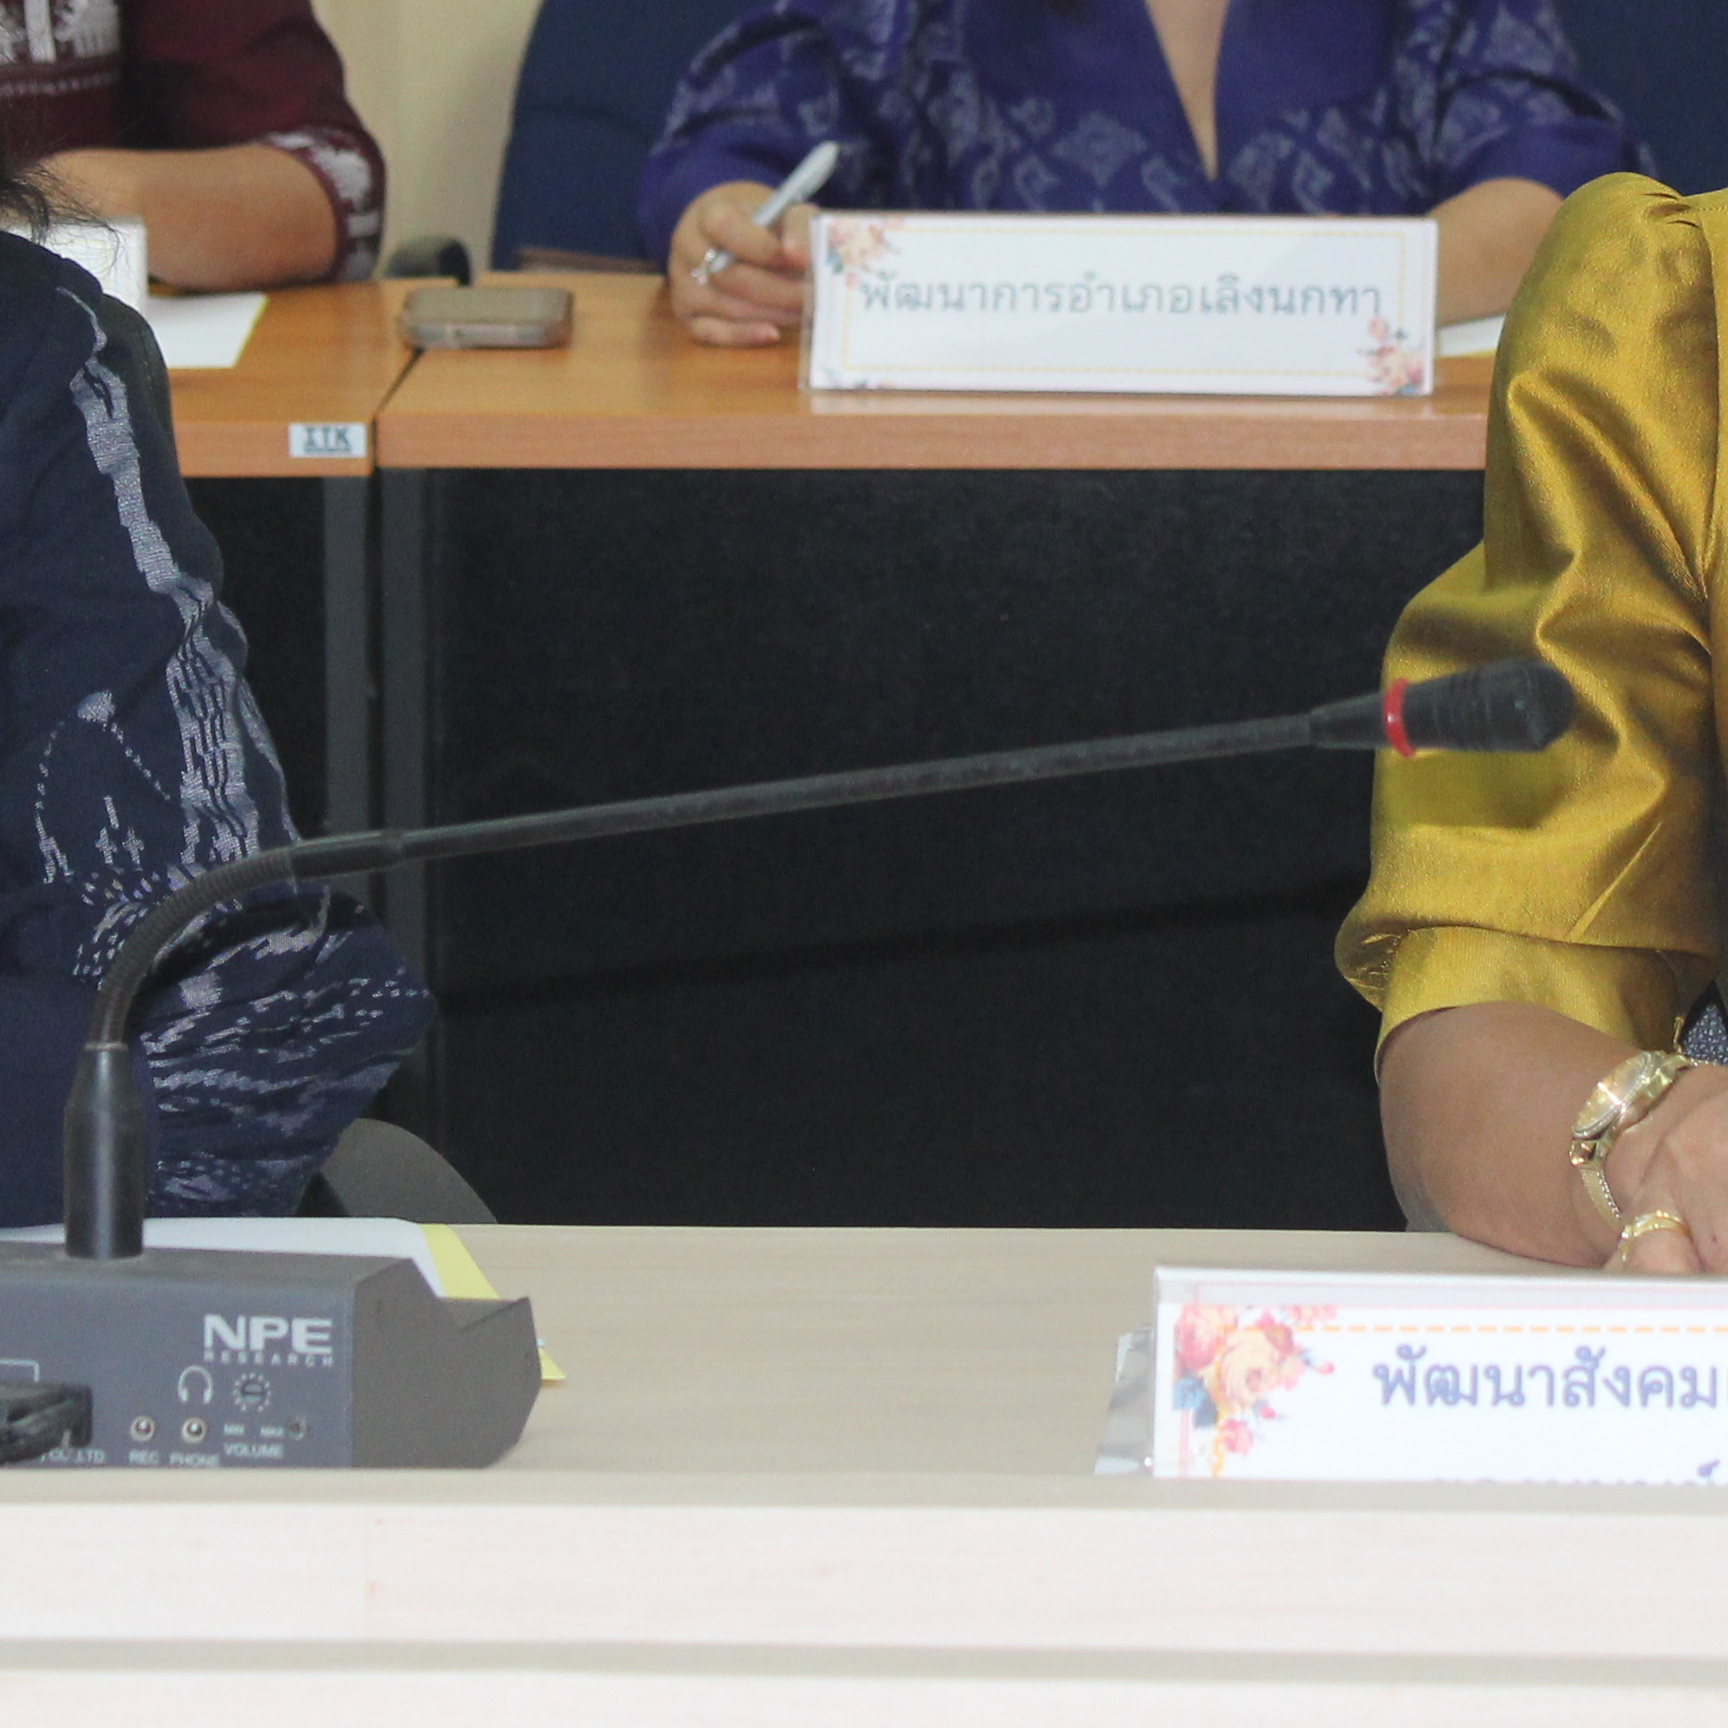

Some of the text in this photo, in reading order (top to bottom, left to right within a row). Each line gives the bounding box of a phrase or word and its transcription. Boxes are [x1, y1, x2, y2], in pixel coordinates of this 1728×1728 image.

[203, 1313, 334, 1355] NPE
[203, 1349, 335, 1368] RESEARCH
[128, 1449, 221, 1468] REC PHONE
[223, 1442, 285, 1460] VOLUME
